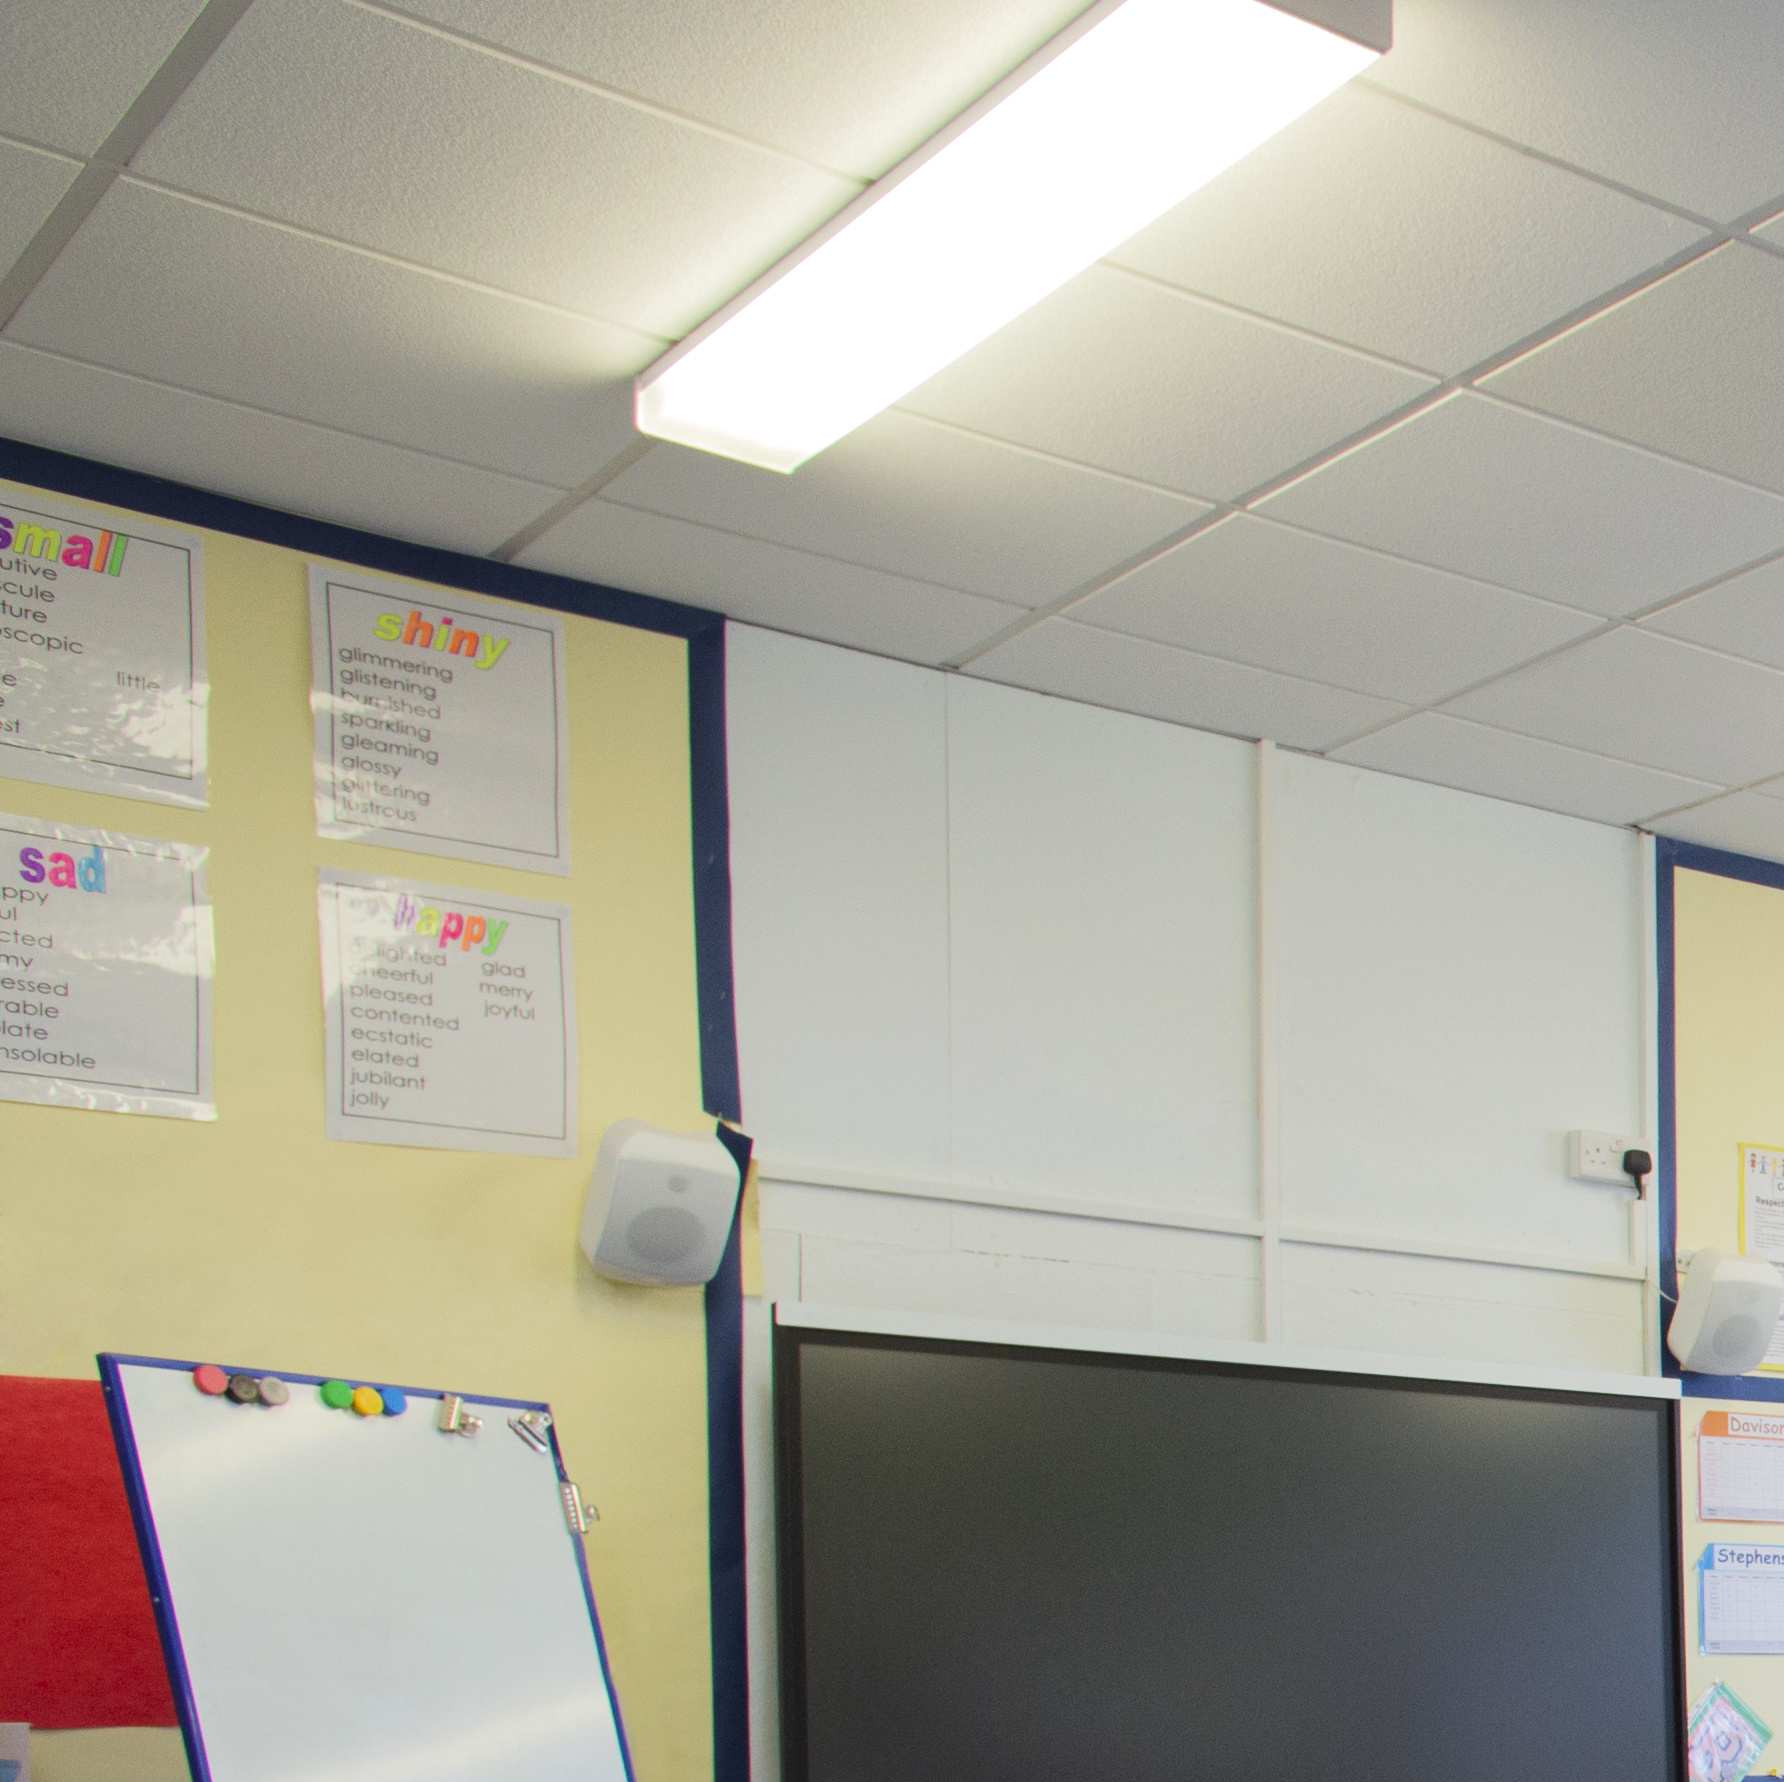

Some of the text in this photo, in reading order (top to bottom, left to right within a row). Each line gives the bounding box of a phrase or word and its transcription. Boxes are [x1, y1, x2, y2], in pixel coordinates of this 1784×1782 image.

[0, 516, 129, 577] small
[373, 609, 510, 670] shiny
[339, 647, 453, 683] glimmering
[114, 671, 161, 690] little
[339, 668, 437, 700] glistening
[340, 710, 431, 742] sparkling
[340, 733, 440, 766] gleaming
[341, 754, 402, 779] glossy
[19, 844, 106, 893] sad
[394, 892, 508, 955] happy
[481, 960, 526, 979] glad
[349, 983, 433, 1007] pleased
[479, 981, 534, 1002] merry
[351, 1005, 460, 1031] contented
[483, 1001, 535, 1021] joyful
[351, 1027, 434, 1050] ecstatic
[351, 1048, 420, 1069] elated
[349, 1067, 426, 1090] jubilant
[349, 1089, 390, 1110] jolly
